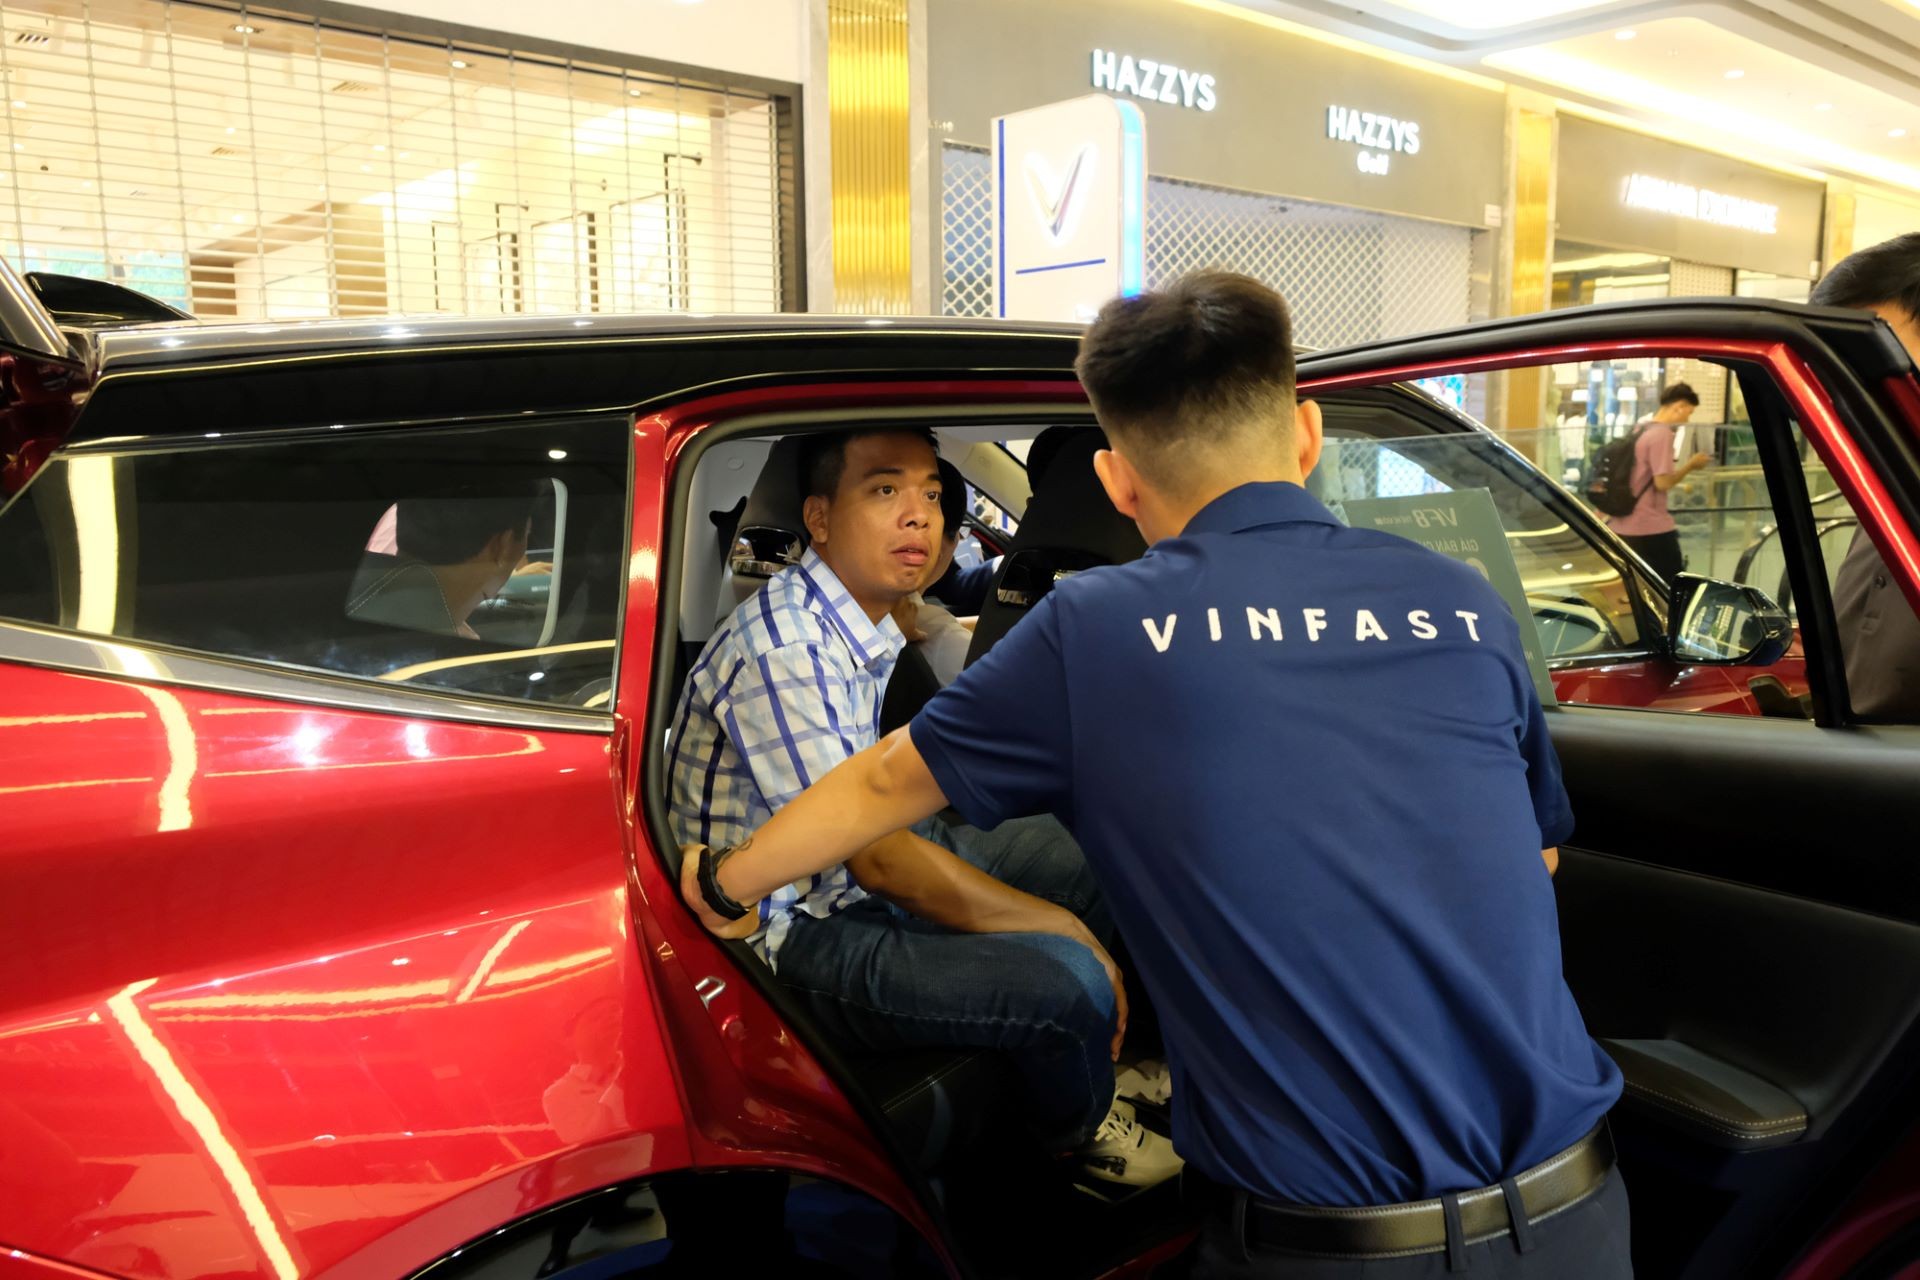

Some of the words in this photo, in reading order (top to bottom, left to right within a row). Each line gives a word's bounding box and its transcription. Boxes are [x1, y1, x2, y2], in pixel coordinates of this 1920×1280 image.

[1091, 49, 1216, 111] HAZZYS
[1328, 105, 1420, 154] HAZZYS
[1142, 606, 1481, 653] VINFAST
